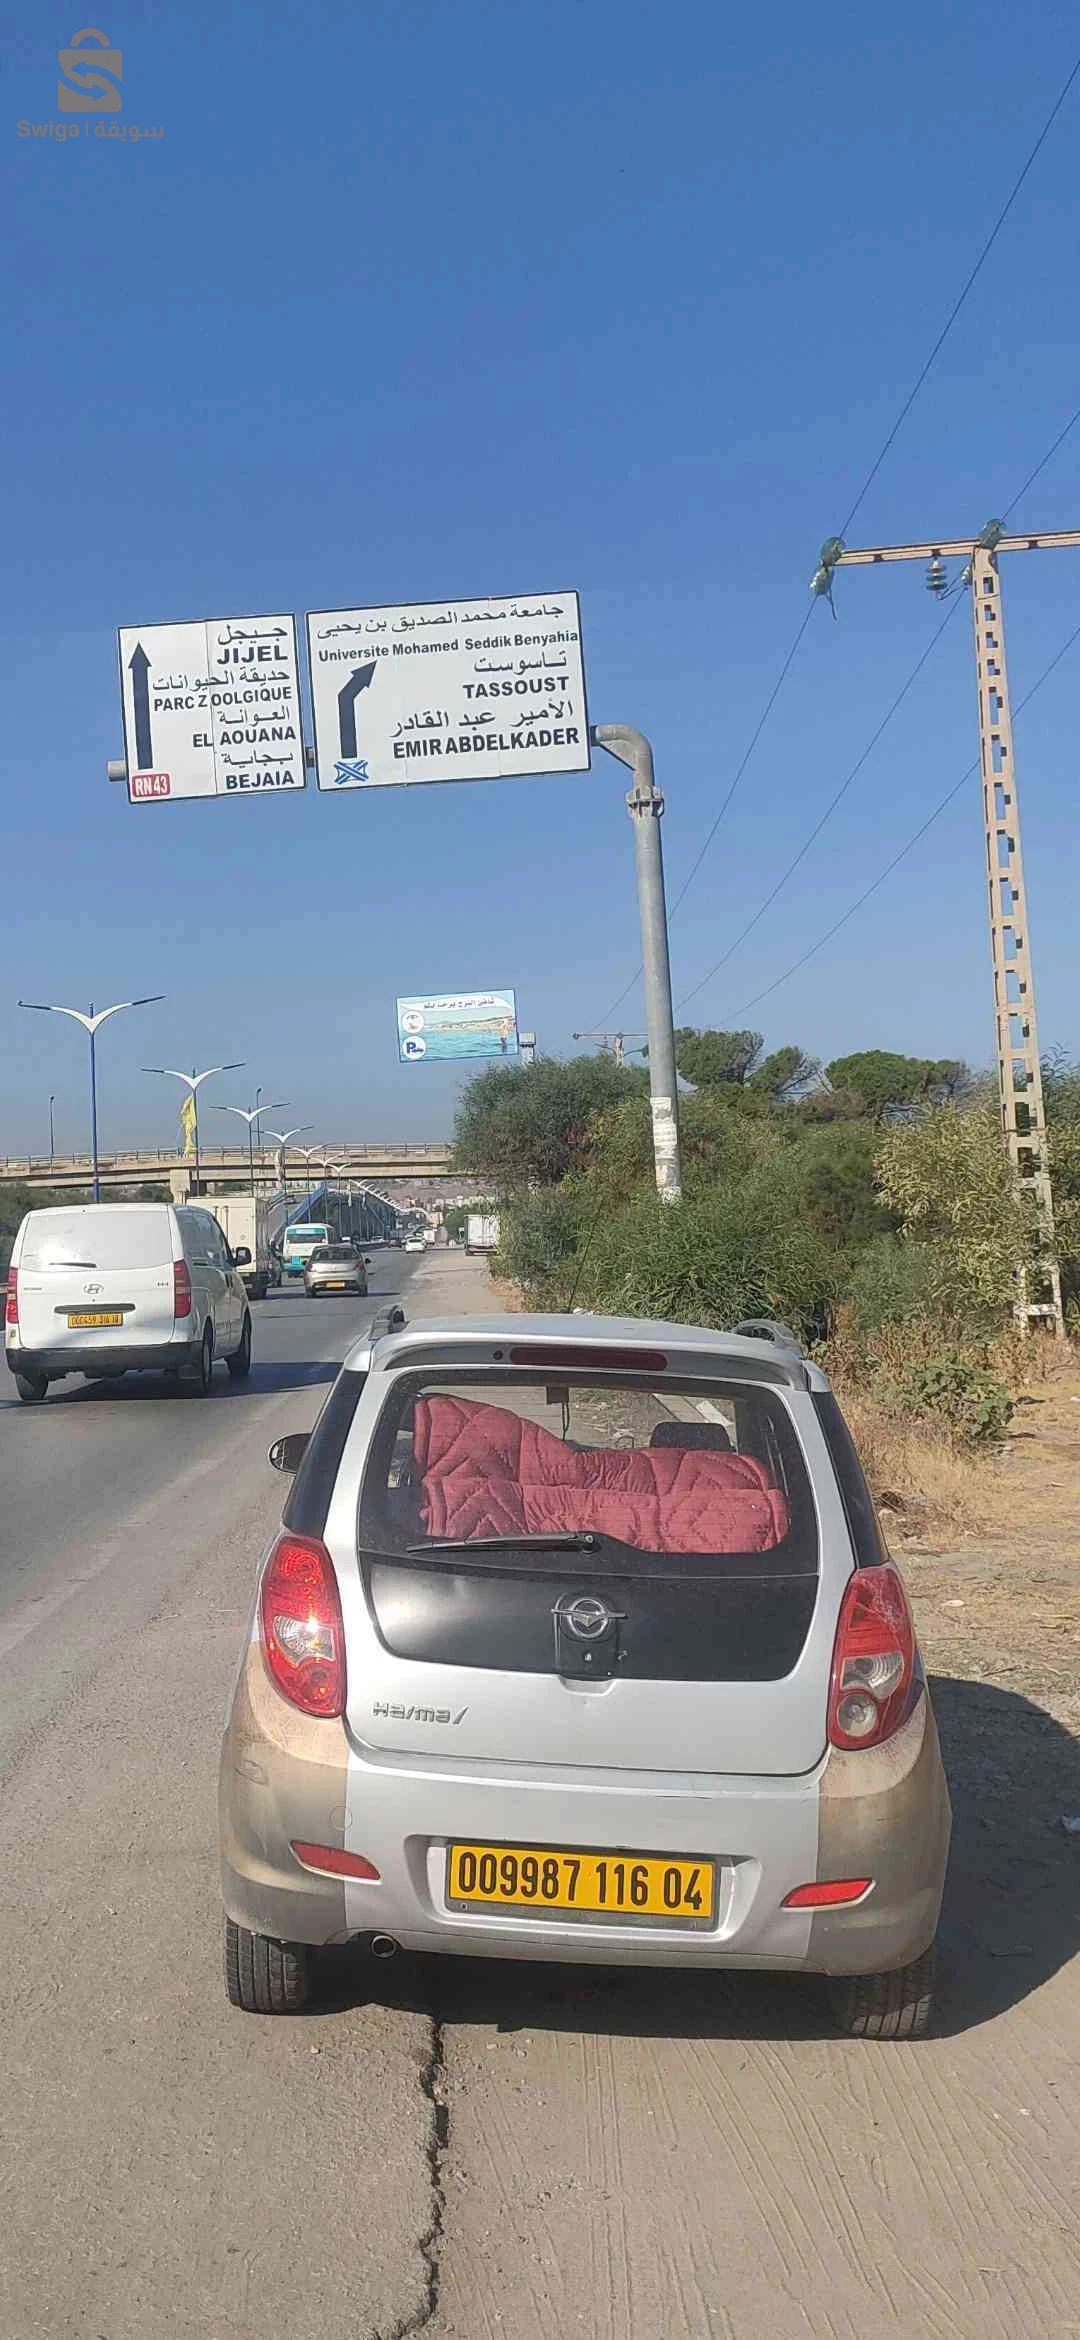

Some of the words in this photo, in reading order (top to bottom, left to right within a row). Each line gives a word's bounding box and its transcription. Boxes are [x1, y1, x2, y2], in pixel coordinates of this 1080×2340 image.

[460, 609, 507, 624] محمد
[509, 602, 565, 619] جامعة
[365, 619, 388, 634] بن
[391, 611, 458, 633] الصديق
[217, 624, 289, 646] جيجل
[216, 645, 288, 665] JIJEL
[318, 646, 389, 663] Universite
[392, 638, 459, 656] Mohamed
[464, 636, 512, 650] Seddik
[514, 630, 579, 648] Benyahia
[473, 649, 568, 676] تاسوست
[152, 670, 235, 694] الحيوانات
[239, 666, 291, 687] حديقة
[462, 676, 569, 699] TASSOUST
[153, 694, 194, 711] PARC
[216, 704, 291, 728] العوانة
[389, 710, 450, 738] القادر
[458, 708, 496, 731] عبد
[193, 733, 213, 748] EL
[220, 726, 297, 746] AOUANA
[393, 734, 444, 760] EMIR
[445, 727, 580, 755] ABDELKADER
[221, 749, 294, 770] بجاية
[226, 770, 295, 790] BEJAIA
[458, 1852, 581, 1902] 009987
[595, 1861, 649, 1906] 116
[663, 1867, 702, 1910] 04
